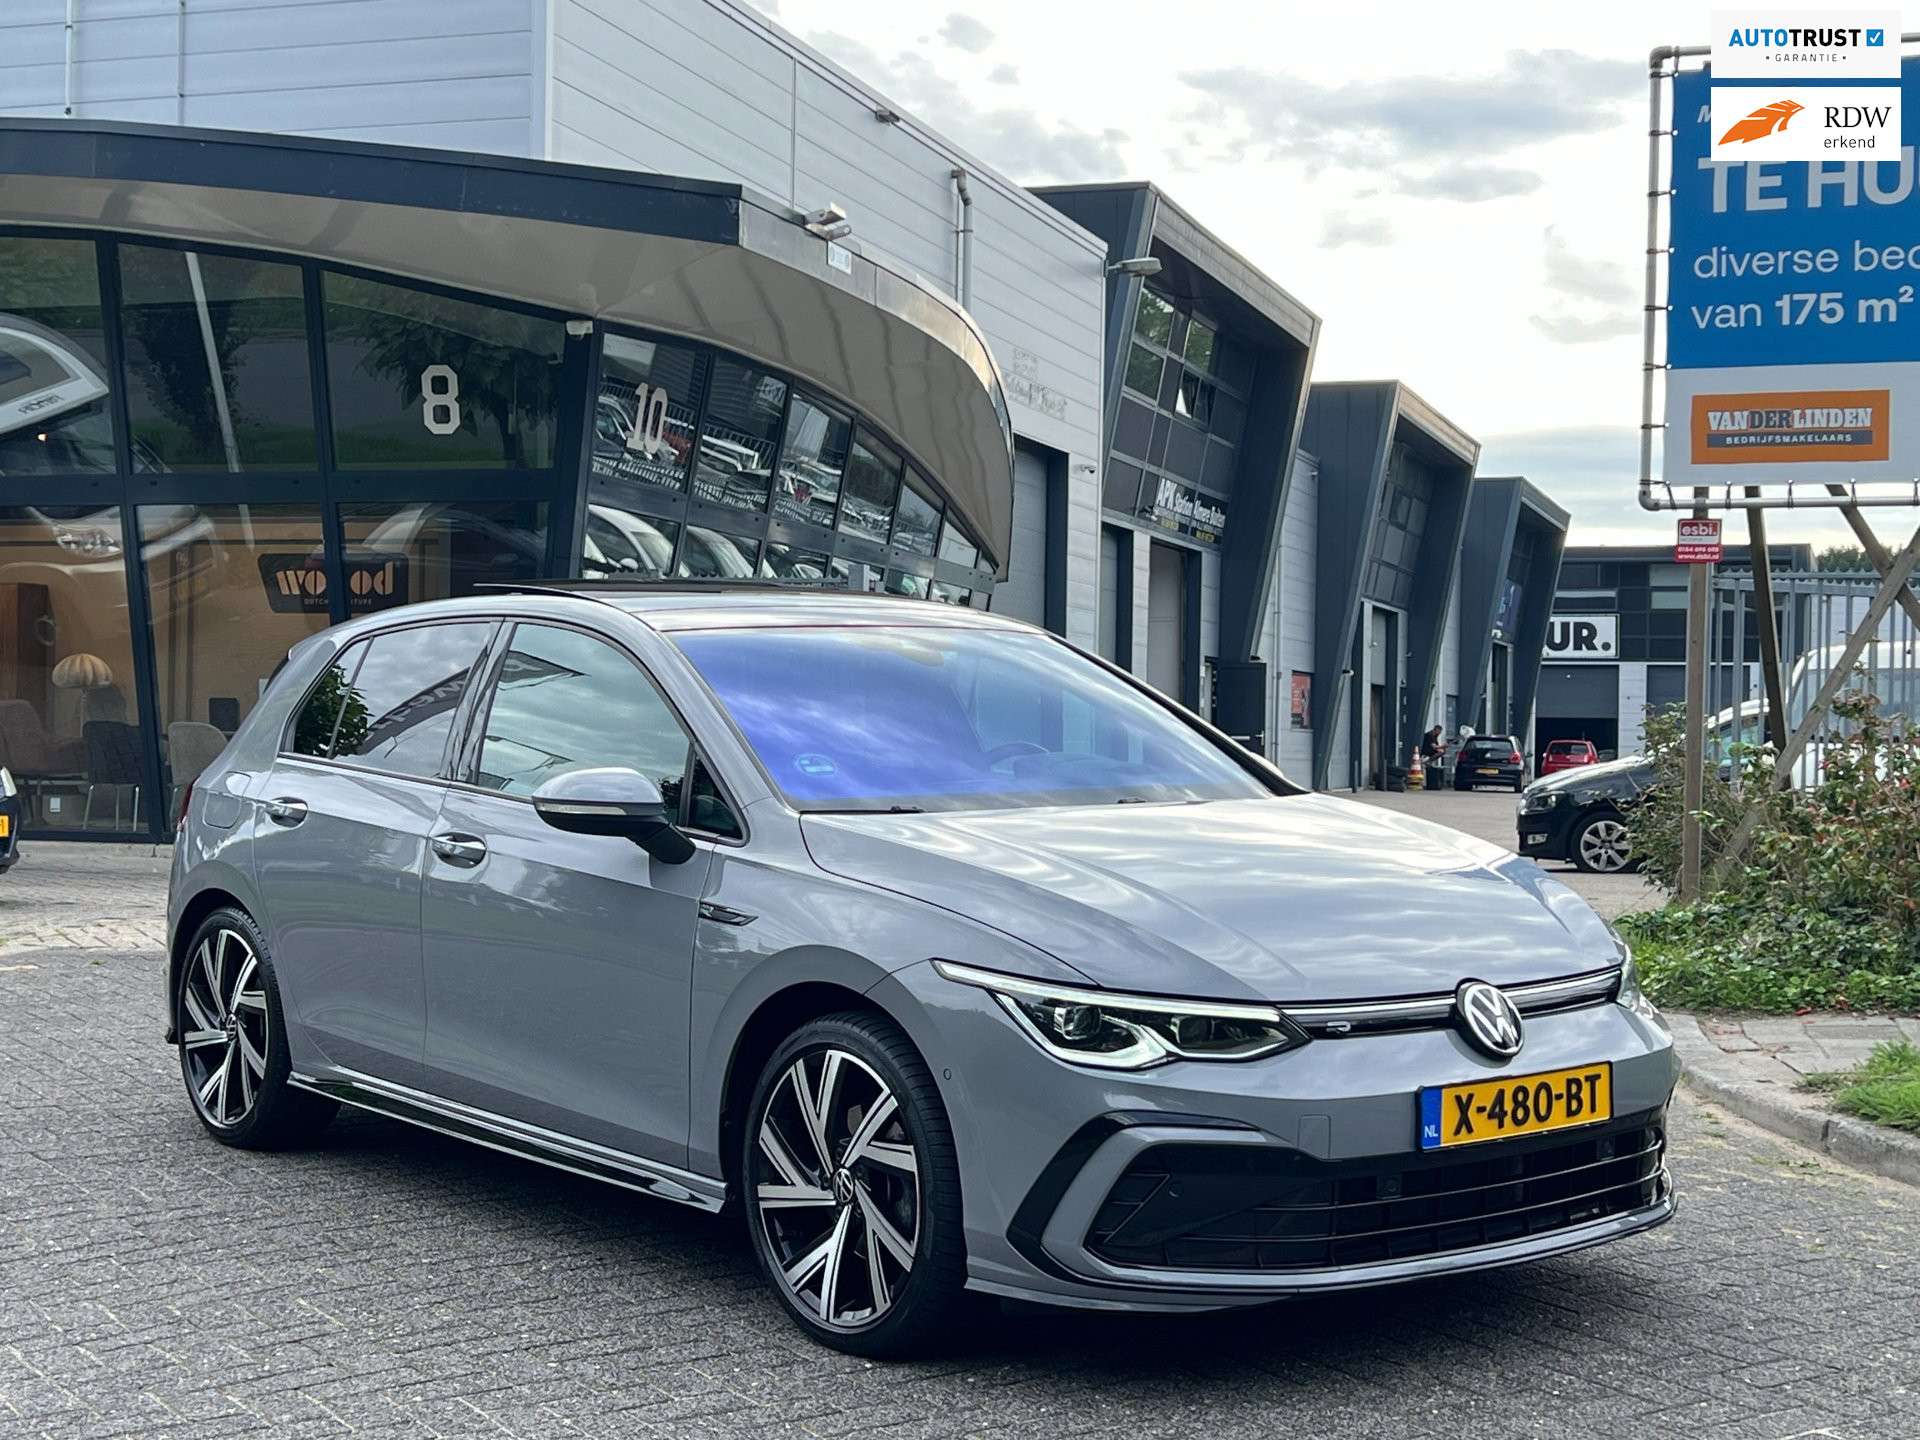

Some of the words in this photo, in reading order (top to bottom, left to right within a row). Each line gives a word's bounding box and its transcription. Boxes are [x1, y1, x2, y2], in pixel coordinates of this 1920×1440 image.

[1697, 157, 1788, 213] TE
[1807, 145, 1920, 209] HU
[1693, 246, 1839, 279] diverse
[1691, 302, 1762, 329] van
[1775, 291, 1845, 326] 175
[421, 364, 462, 435] 8
[626, 382, 668, 454] 10
[1725, 433, 1853, 445] BEDRIJFSMAKELAARS
[1453, 1073, 1602, 1137] X-480-BT
[1424, 1126, 1439, 1138] NL
